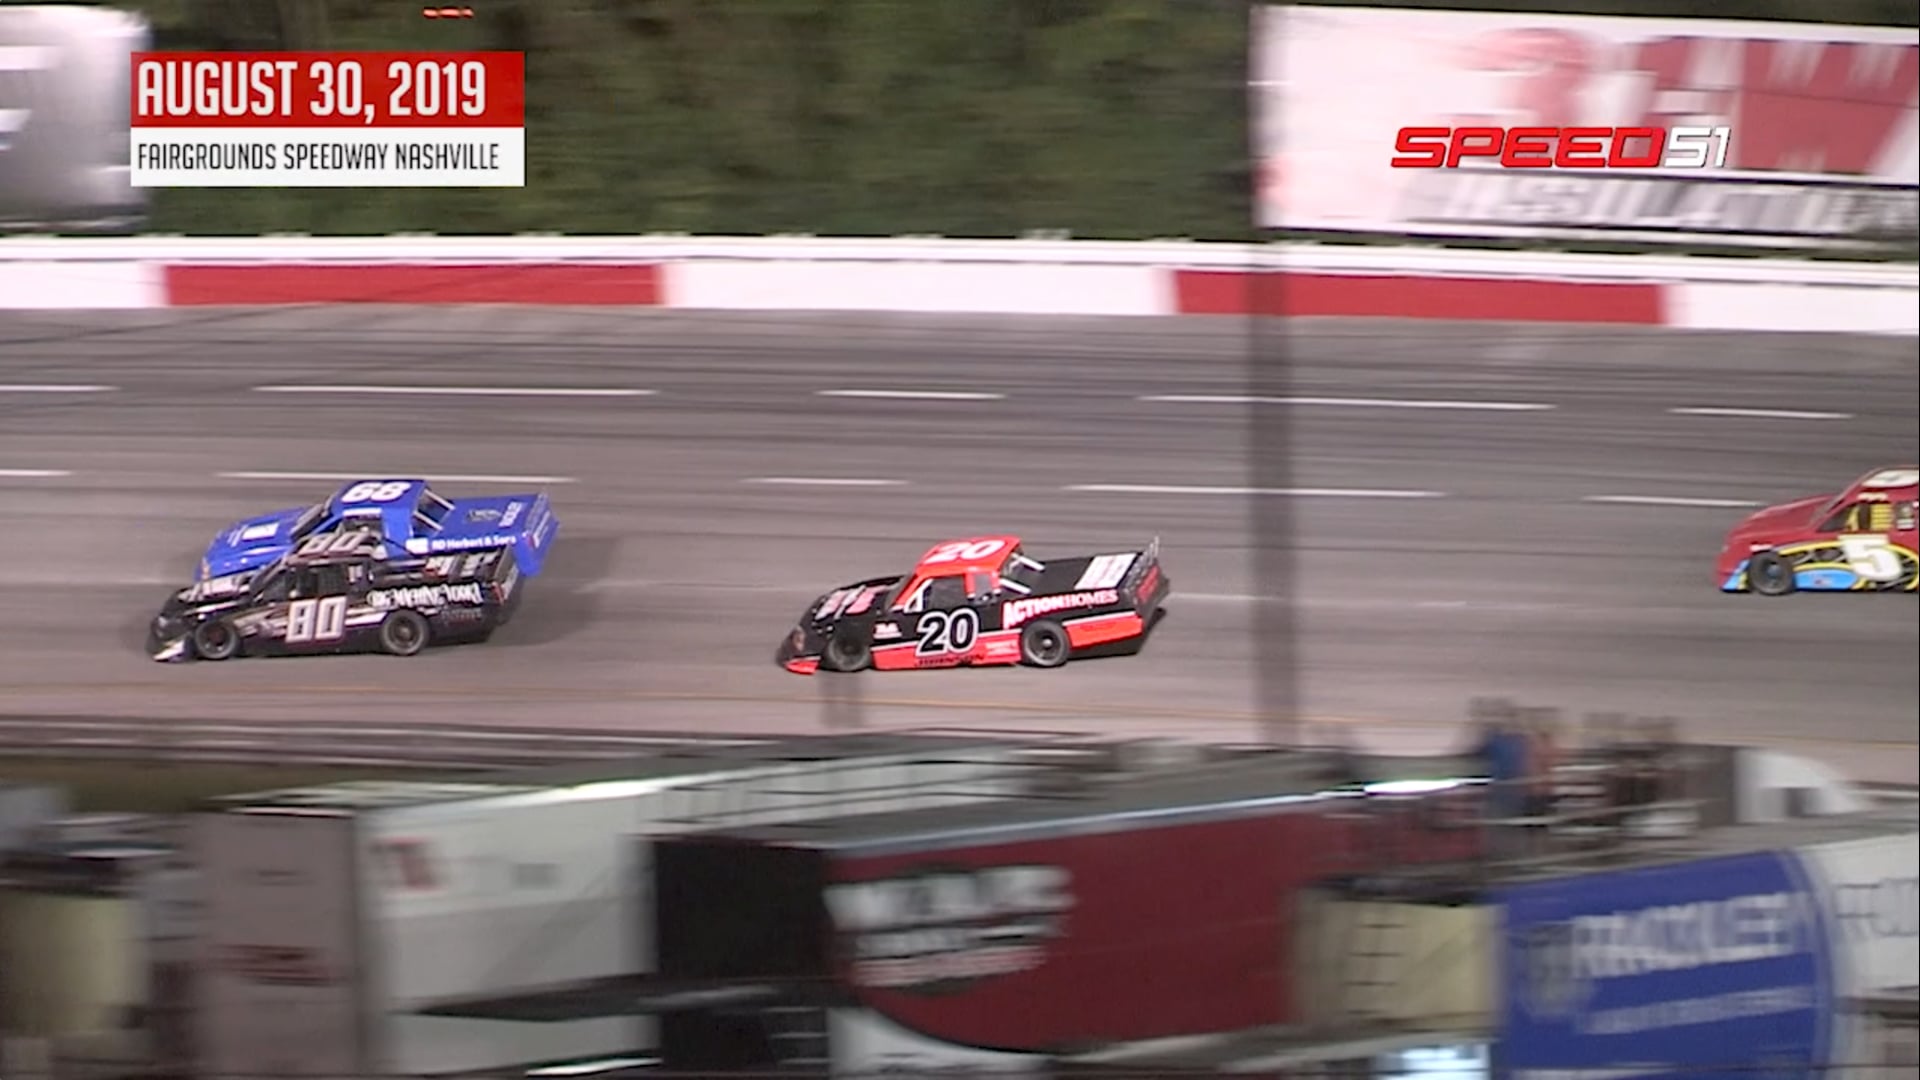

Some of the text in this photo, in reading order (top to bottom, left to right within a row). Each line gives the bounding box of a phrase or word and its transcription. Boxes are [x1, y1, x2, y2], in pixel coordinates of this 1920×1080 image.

[341, 481, 412, 503] 68
[924, 540, 1006, 565] 20
[1838, 534, 1902, 582] 5
[285, 596, 346, 643] 80
[916, 608, 979, 656] 20
